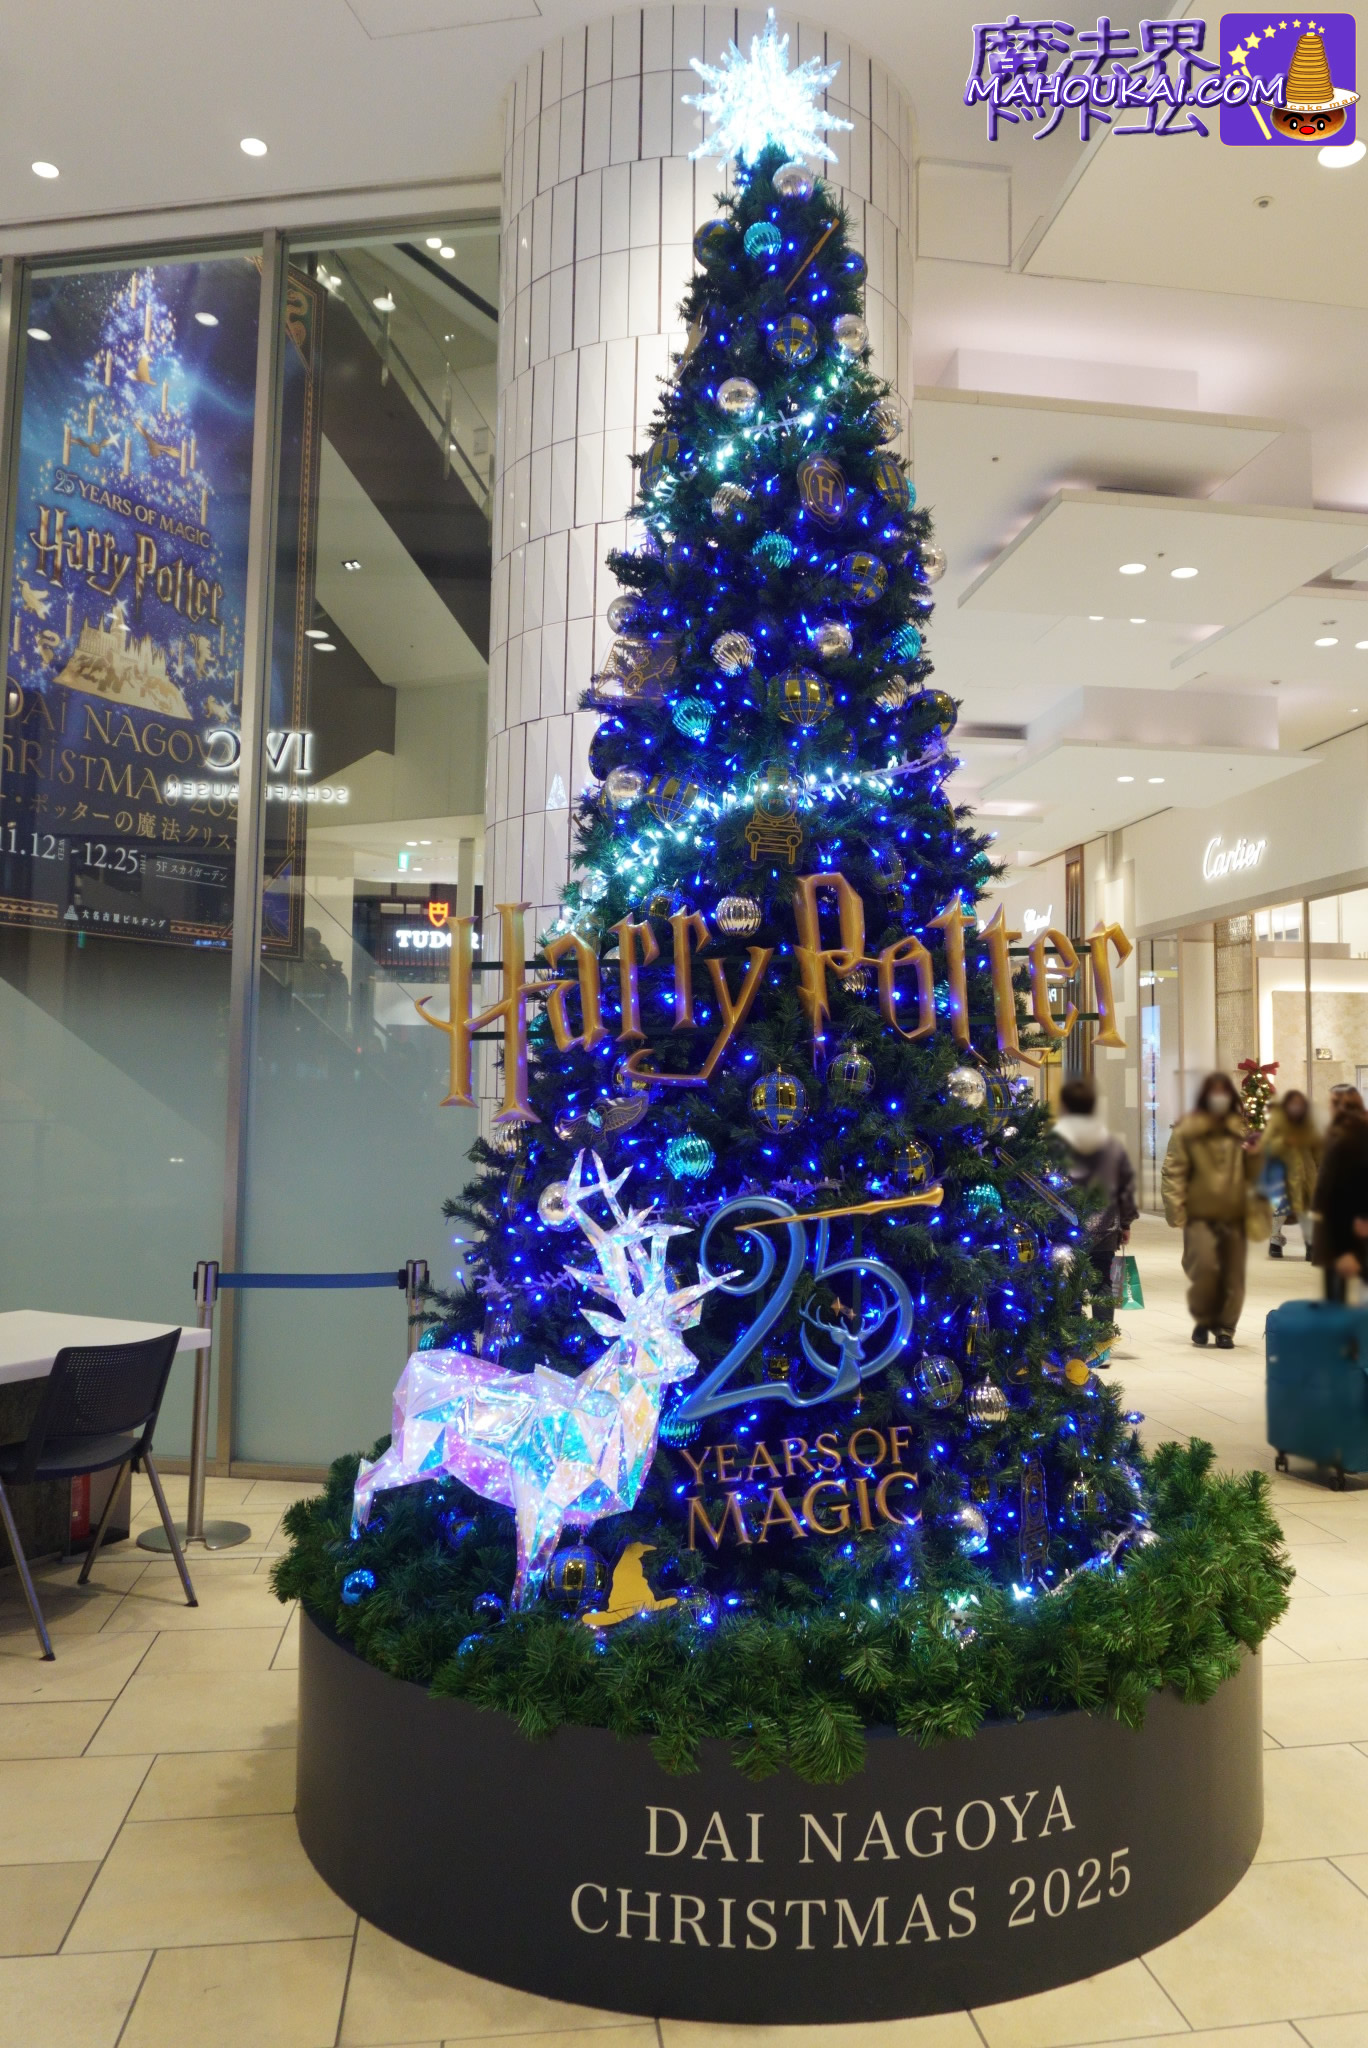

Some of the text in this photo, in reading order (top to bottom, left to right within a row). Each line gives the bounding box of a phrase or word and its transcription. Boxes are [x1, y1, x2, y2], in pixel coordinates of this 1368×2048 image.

[54, 469, 210, 547] 25 YEARS OF MAGIC
[815, 474, 835, 506] H
[30, 505, 224, 625] Harry Potter
[83, 842, 138, 874] 12.25
[155, 861, 168, 873] 5F
[170, 864, 227, 881] スカイガーデン
[1203, 836, 1267, 880] Cartier
[396, 930, 480, 950] TUDR
[416, 872, 1133, 1123] Harry Potter
[679, 1188, 943, 1421] 25
[679, 1426, 913, 1486] YEARS OF
[686, 1471, 923, 1551] MAGIC
[645, 1785, 1077, 1863] DAI NAGOYA
[570, 1847, 1132, 1950] CHRISTMAS 2025
